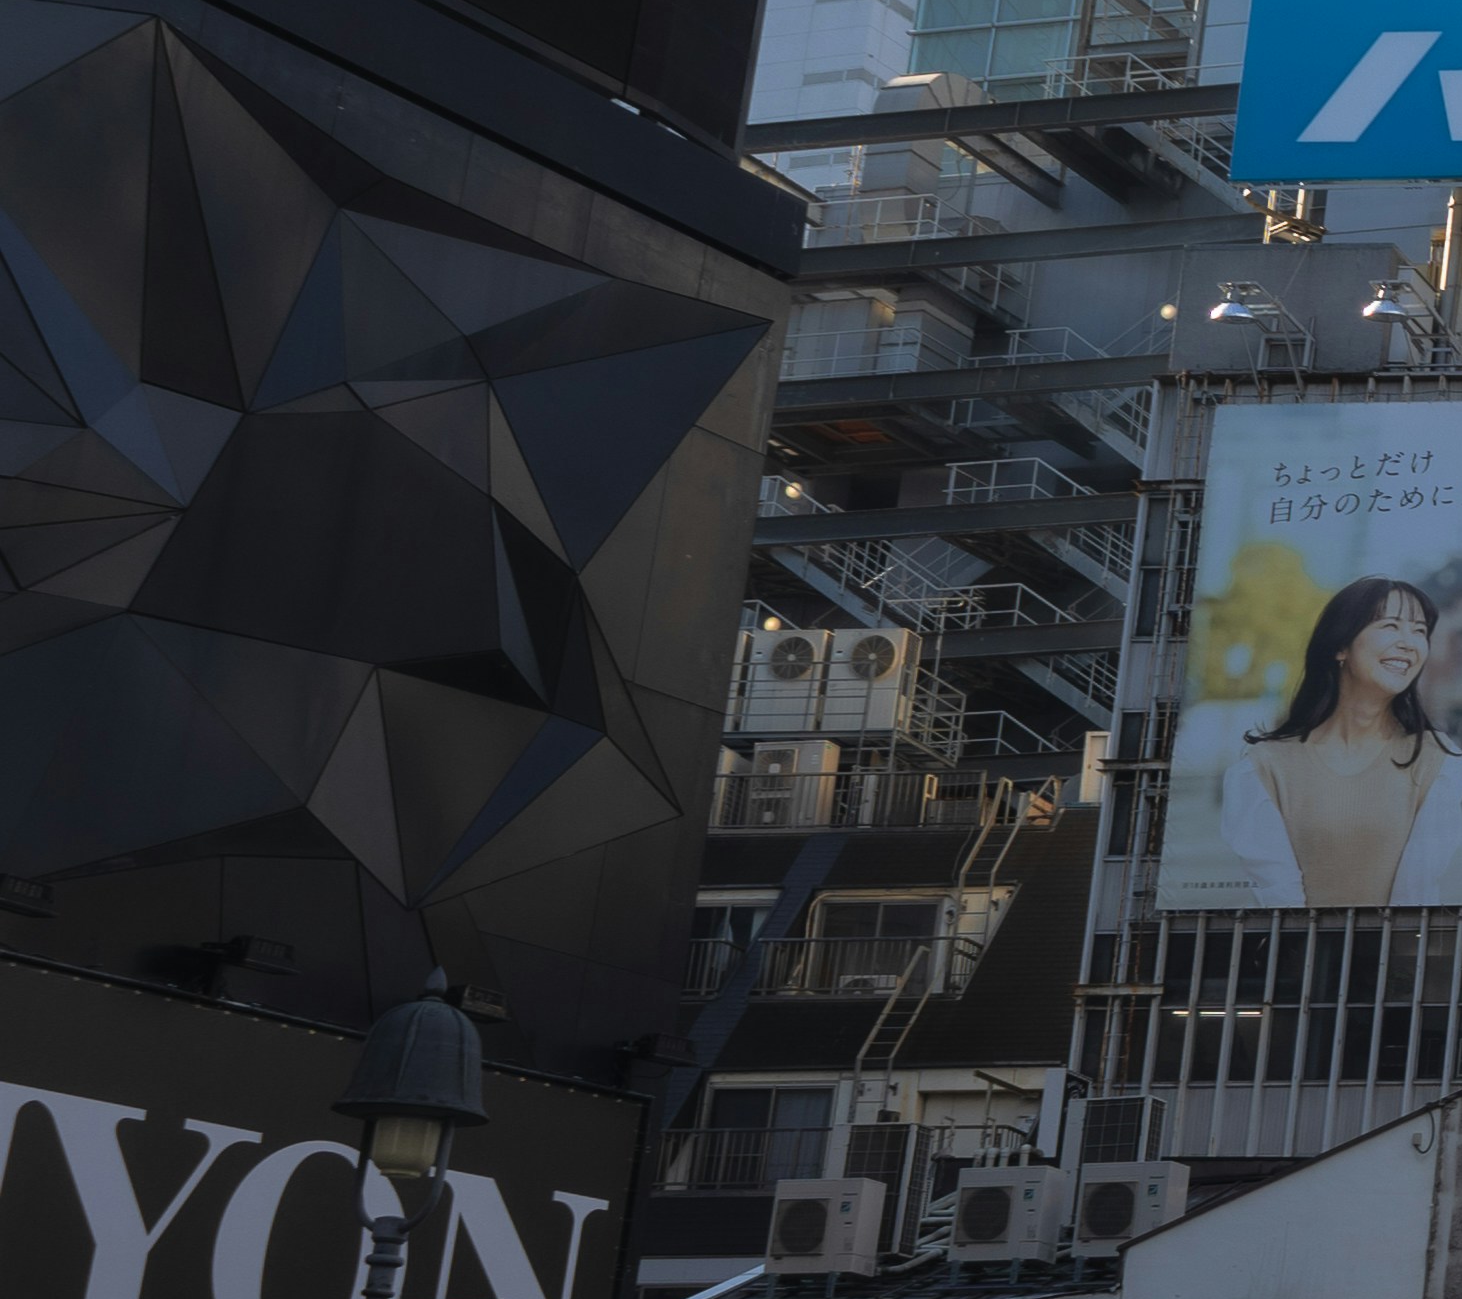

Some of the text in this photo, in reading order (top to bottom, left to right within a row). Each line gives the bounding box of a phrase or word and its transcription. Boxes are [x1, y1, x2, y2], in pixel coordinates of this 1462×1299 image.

[1272, 450, 1434, 488] ちょっとだけ
